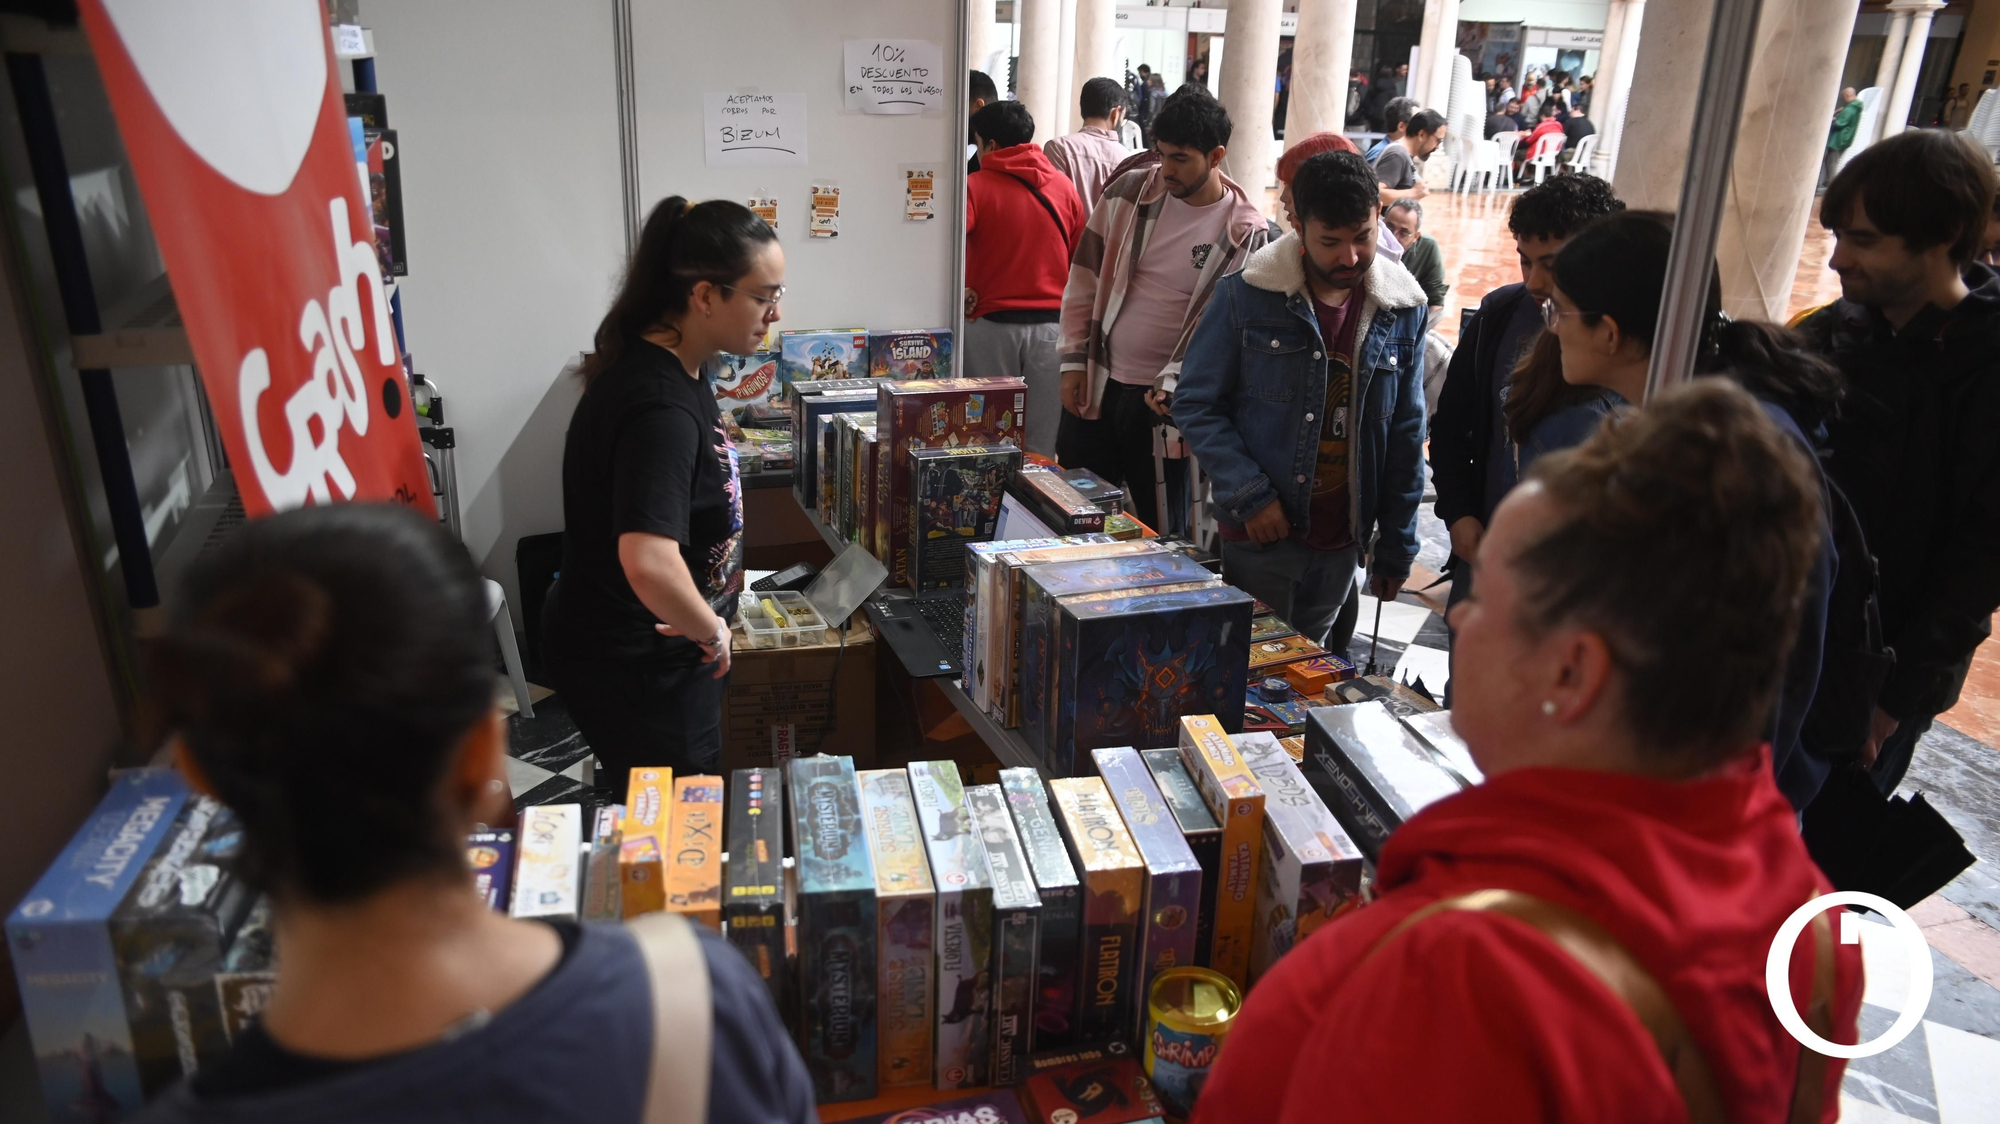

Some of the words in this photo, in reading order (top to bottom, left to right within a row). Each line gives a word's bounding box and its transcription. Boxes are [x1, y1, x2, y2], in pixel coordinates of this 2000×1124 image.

[871, 43, 905, 63] 10%
[861, 67, 929, 79] DESCUENTO
[726, 95, 774, 104] ACEPTAMOS
[849, 84, 863, 94] EN
[872, 85, 894, 94] TODOS
[900, 85, 912, 94] LOS
[918, 85, 943, 95] JUEGOS
[722, 107, 748, 115] COBROS
[762, 107, 777, 115] POR
[892, 346, 931, 360] ISLAND
[899, 339, 924, 347] SURVIVE
[895, 548, 907, 584] CATAN
[1324, 656, 1349, 669] SCOUT
[918, 779, 938, 809] FLORESTA
[811, 789, 841, 850] MYSTERIUM
[873, 805, 897, 853] SUNRISE
[86, 796, 171, 891] MEGACITY
[944, 922, 962, 972] FLORESTA
[1096, 935, 1121, 1006] FLATIRON
[827, 950, 852, 1047] MYSTERIUM
[888, 959, 905, 1030] SUNRISE
[1001, 1015, 1013, 1034] ART
[1001, 1036, 1012, 1083] CLASSIC
